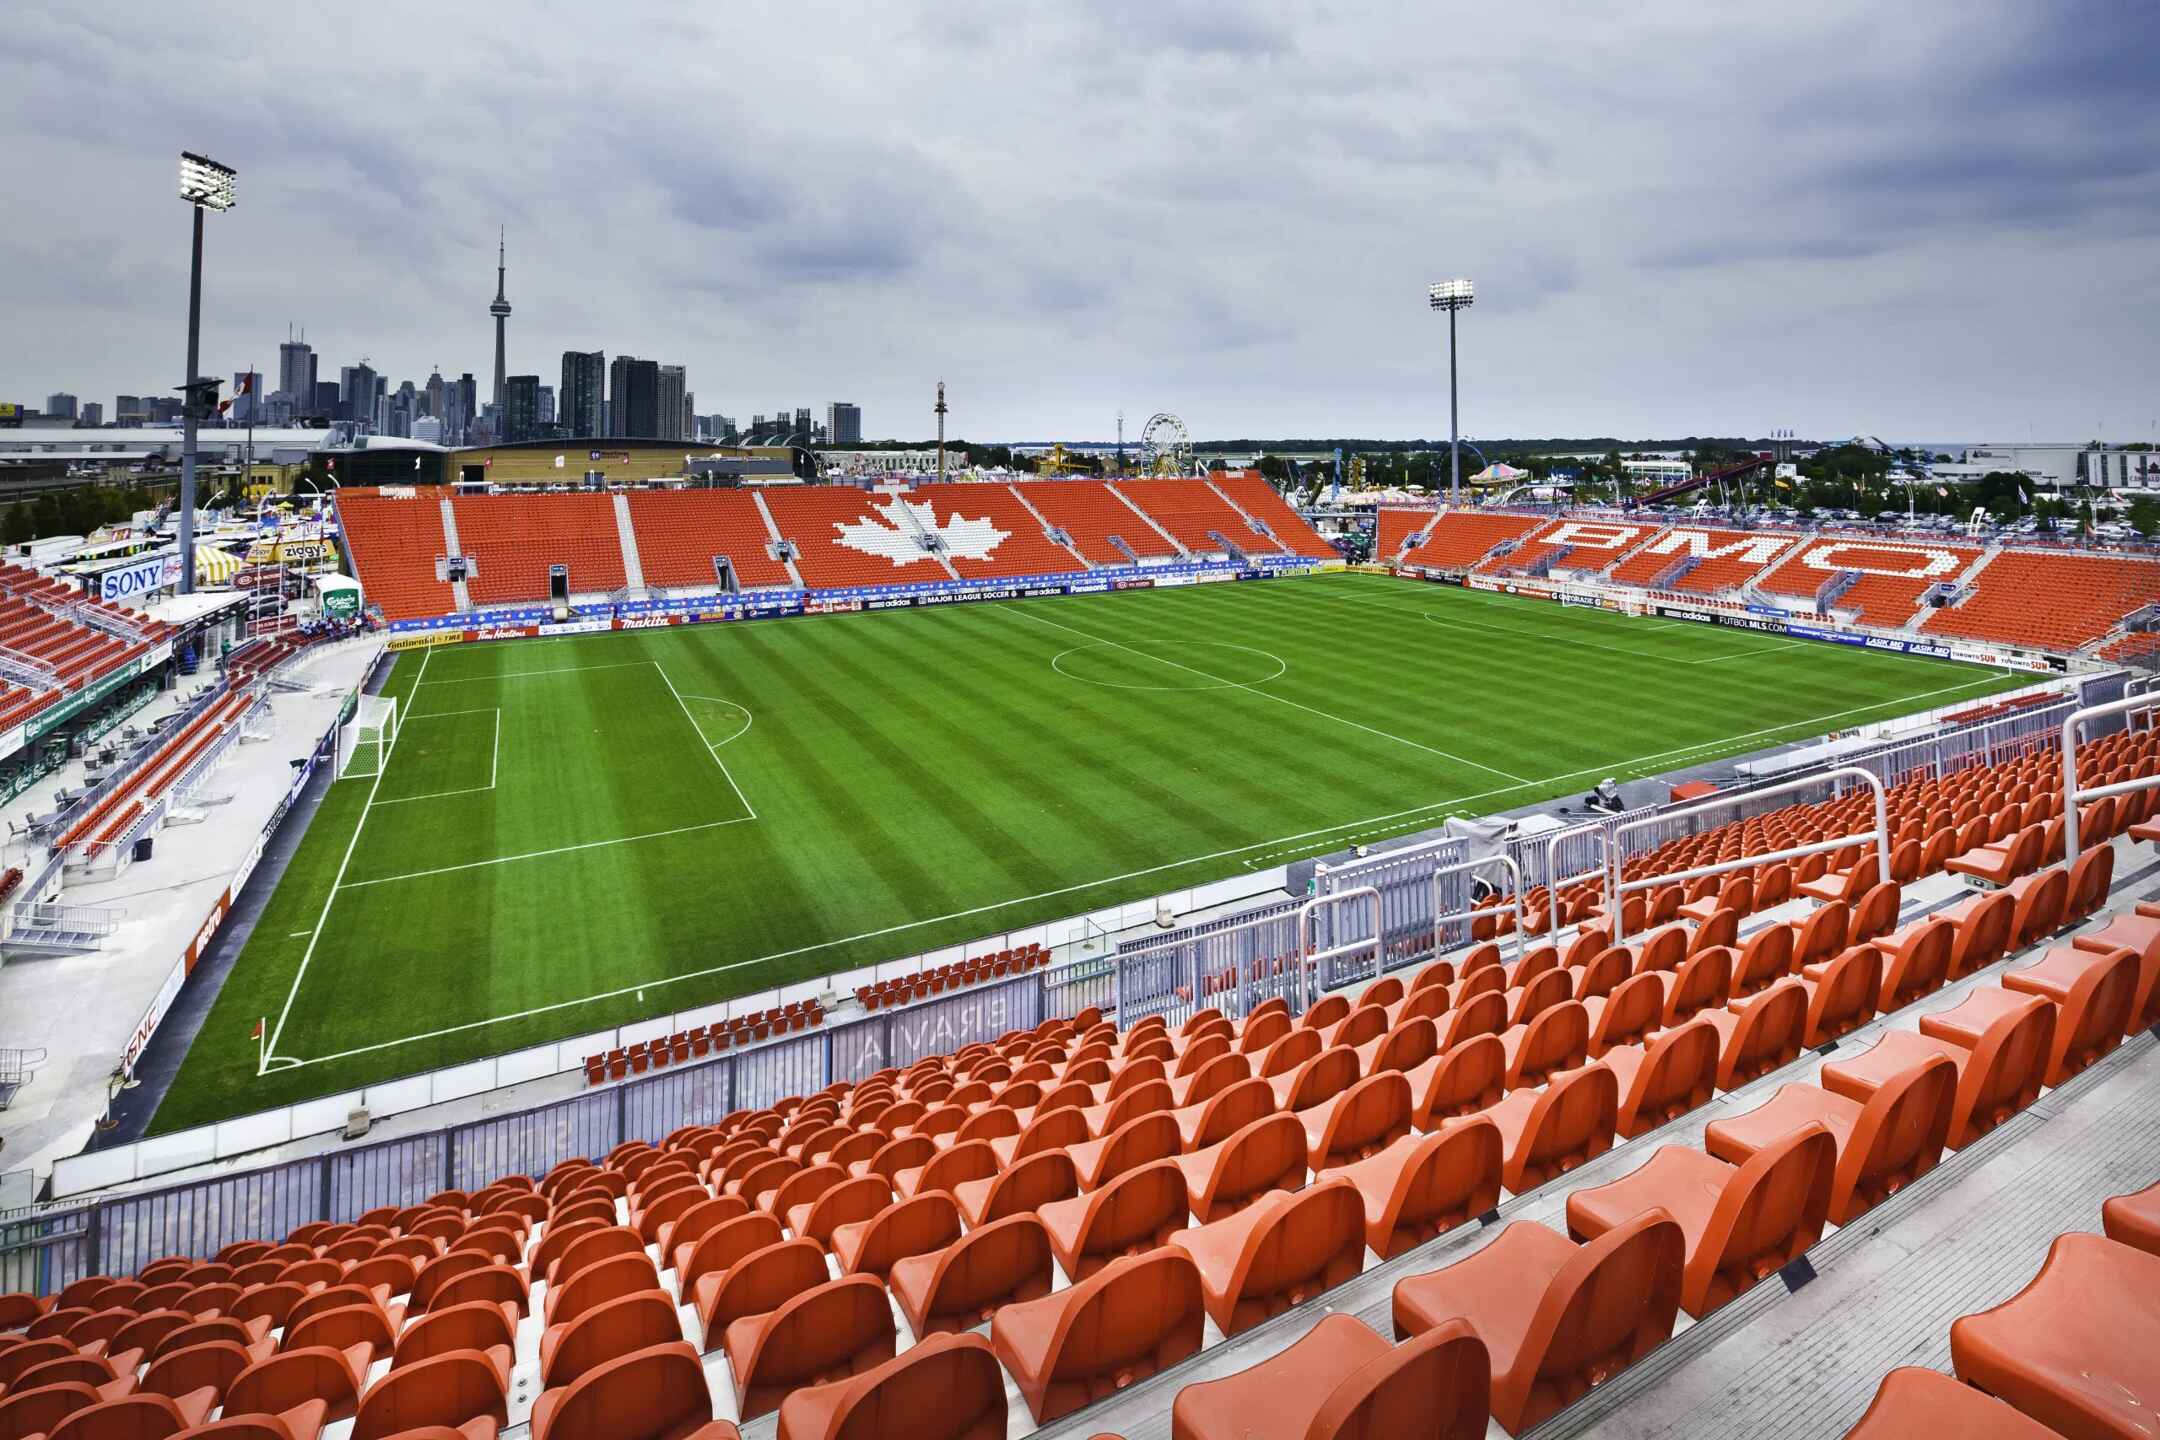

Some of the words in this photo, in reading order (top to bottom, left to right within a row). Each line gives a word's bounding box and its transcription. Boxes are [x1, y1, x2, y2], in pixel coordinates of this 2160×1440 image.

[1538, 522, 1959, 578] BMO
[104, 565, 161, 600] SONY
[885, 599, 911, 608] adidas
[927, 594, 953, 604] MAJOR
[953, 593, 982, 602] LEAGUE
[982, 590, 1009, 600] SOCCER
[1682, 612, 1711, 623] adidas
[1719, 616, 1788, 633] FUTBOLMLS.COM
[476, 631, 493, 641] Tim
[493, 629, 526, 640] Hortons
[388, 635, 435, 650] Continental
[1865, 637, 1888, 647] LASIK
[1889, 641, 1904, 650] MD
[1910, 643, 1933, 653] LASIK
[1934, 647, 1950, 656] MD
[1980, 652, 1997, 664] SUN
[2031, 660, 2049, 672] SUN
